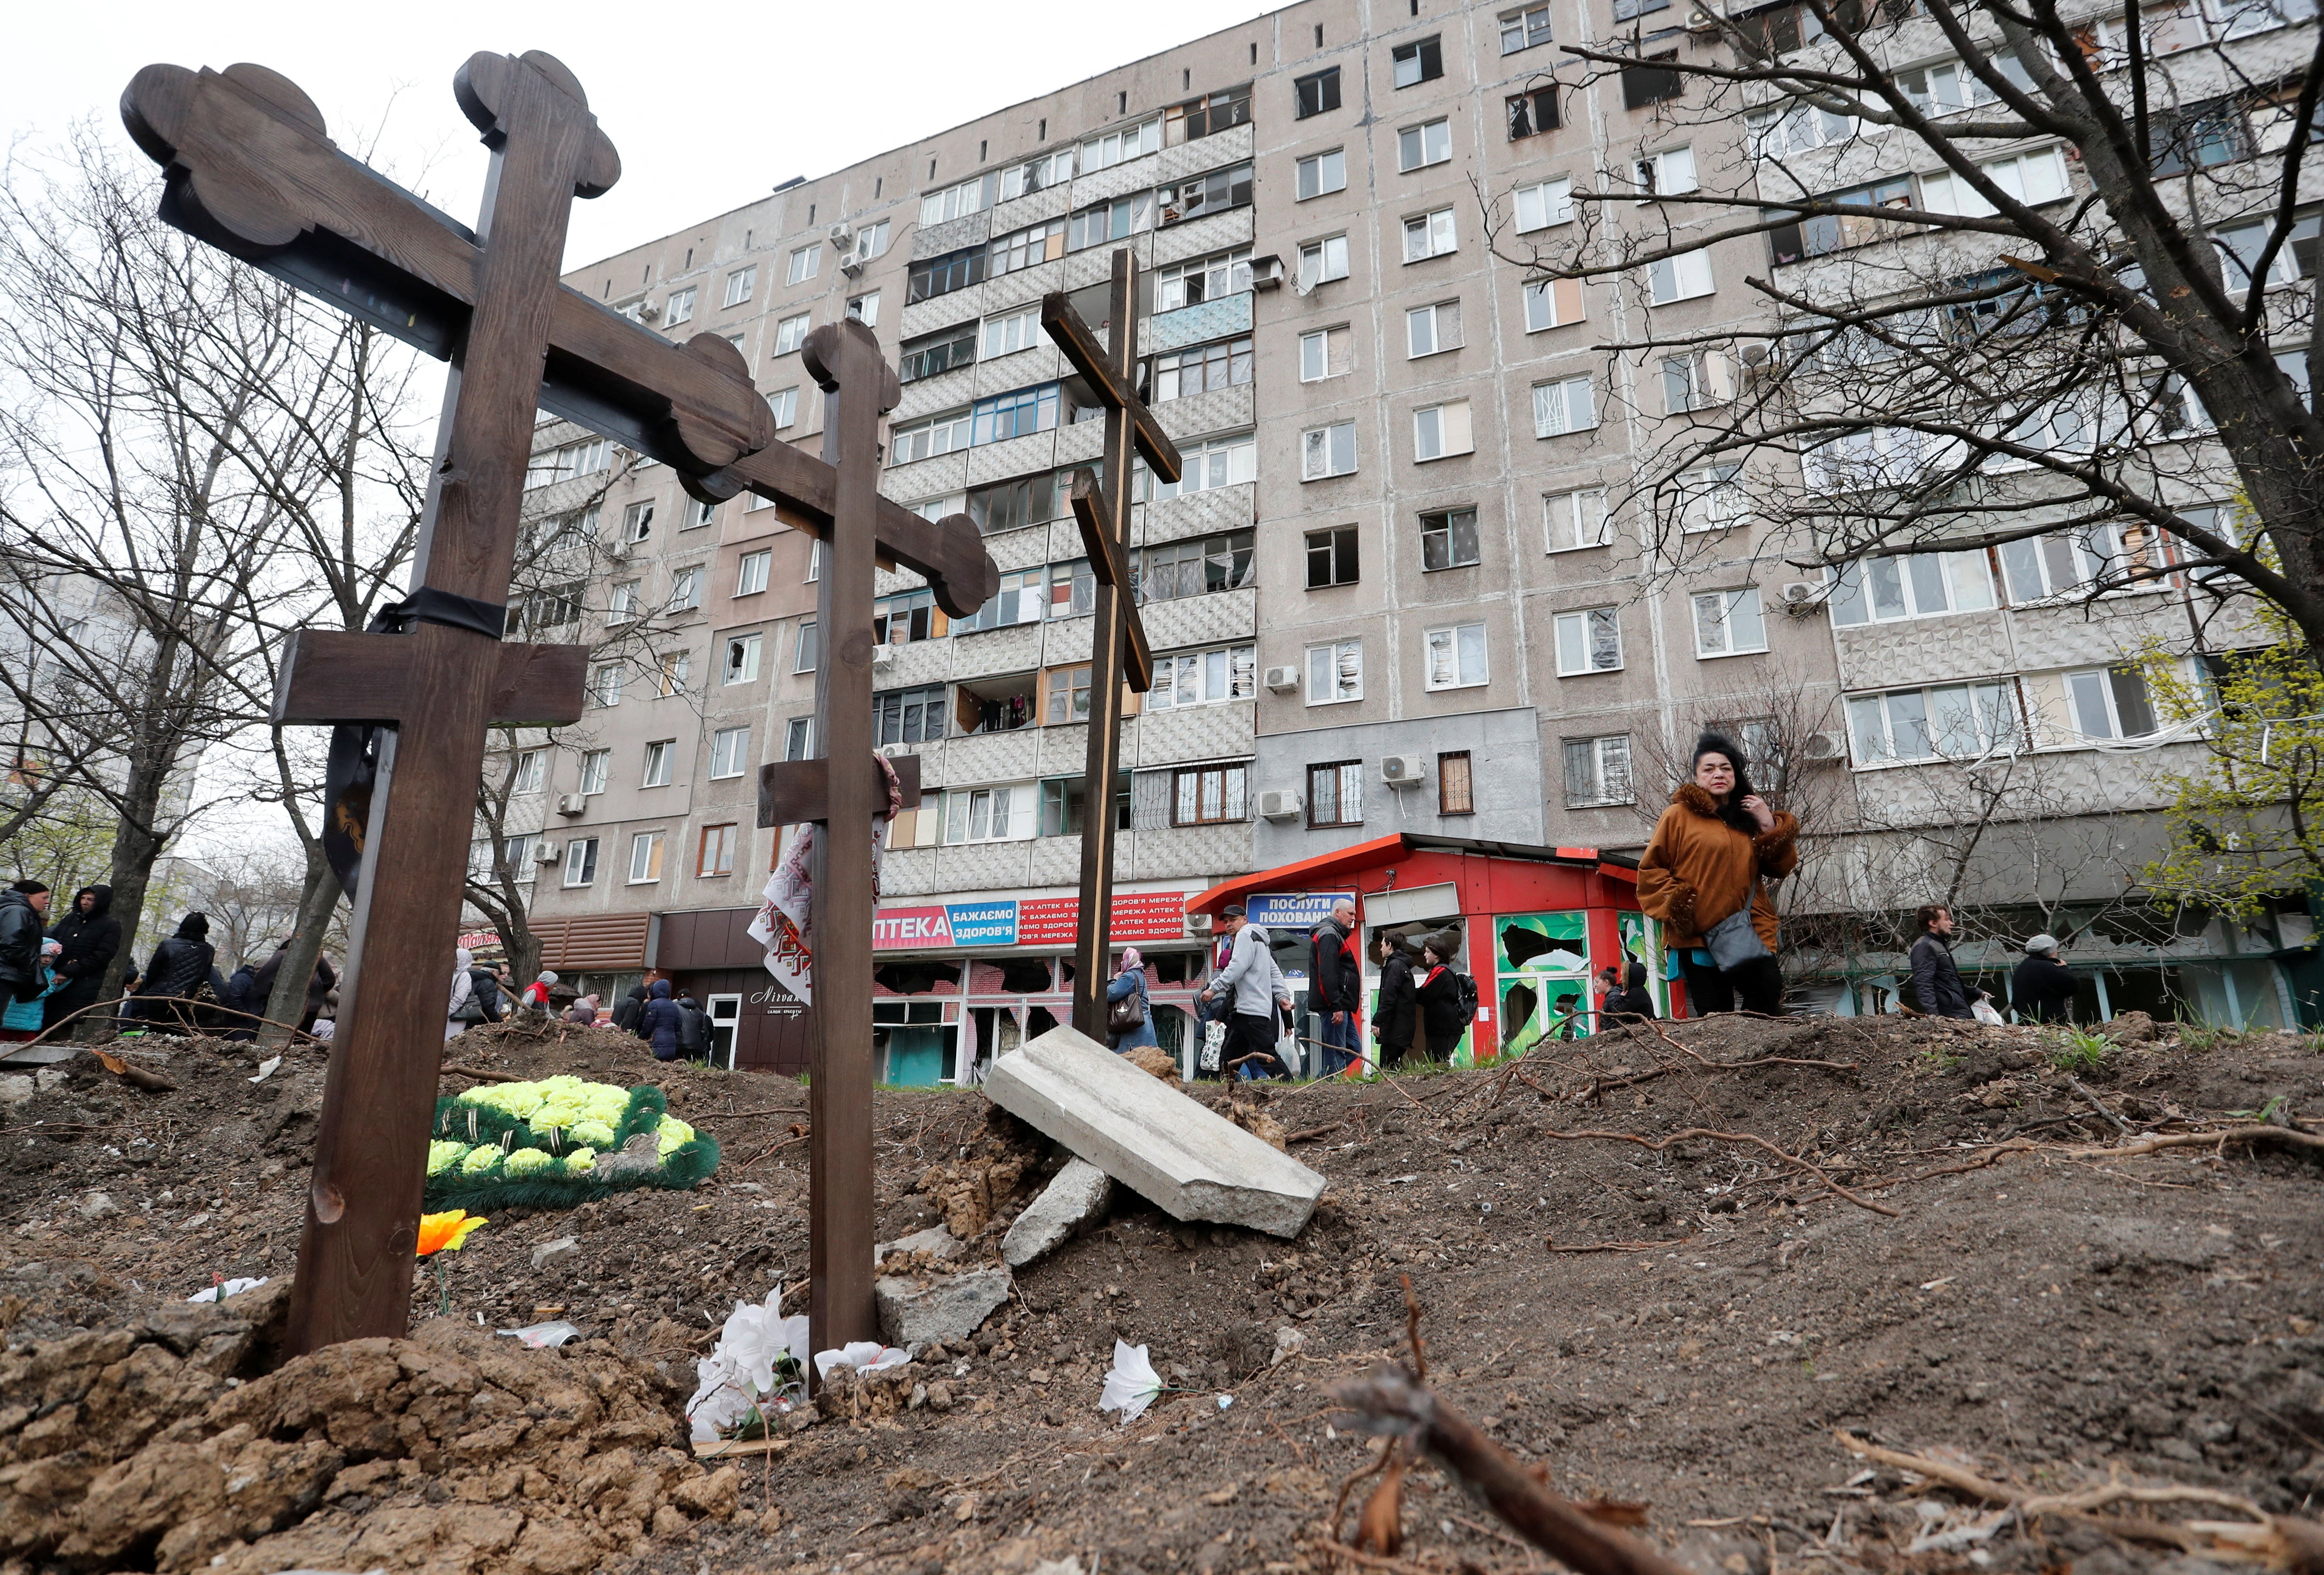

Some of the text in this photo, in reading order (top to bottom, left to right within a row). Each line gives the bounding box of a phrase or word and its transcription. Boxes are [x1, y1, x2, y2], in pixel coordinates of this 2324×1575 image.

[1269, 898, 1330, 909] ПОСЛУГИ
[953, 909, 1013, 922] БАЖАЄМО
[955, 926, 1013, 940] ЗДОРОВ'Я
[750, 985, 803, 1004] Nirvan
